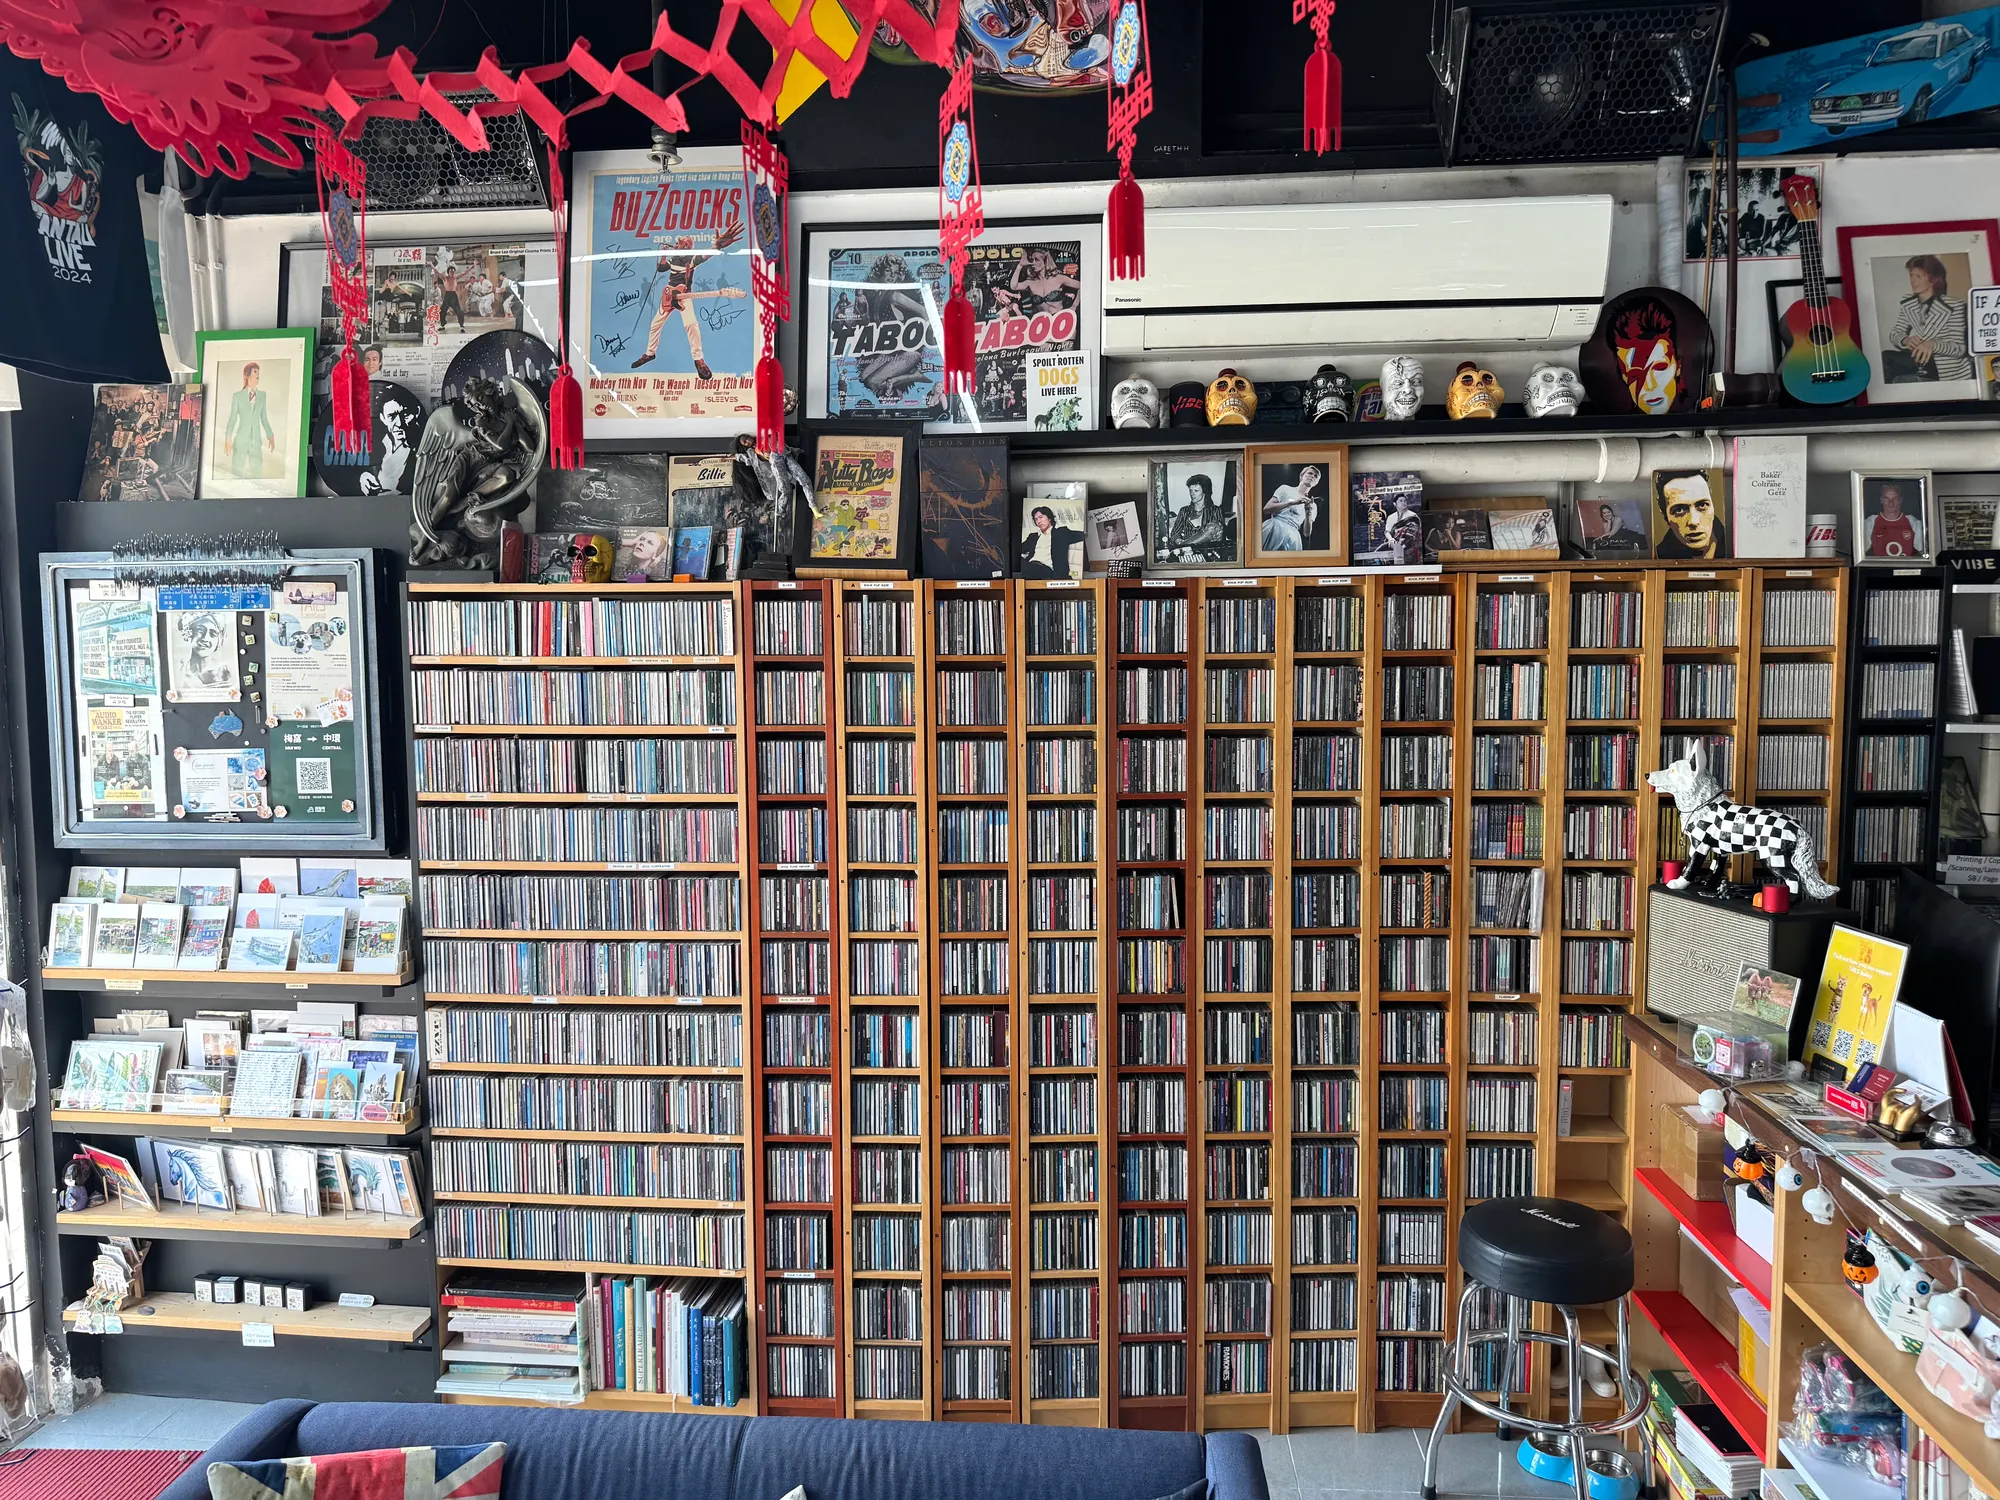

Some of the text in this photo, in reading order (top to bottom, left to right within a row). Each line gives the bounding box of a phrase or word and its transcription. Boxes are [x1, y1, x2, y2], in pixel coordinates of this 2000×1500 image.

[609, 183, 742, 238] BUZZCOCKS
[653, 235, 671, 243] are
[44, 235, 92, 271] LIVE
[52, 265, 92, 284] 2024
[1975, 296, 1988, 309] IF
[1978, 328, 1997, 338] THIS
[1985, 339, 1997, 348] BE
[1033, 356, 1084, 368] SPOILT ROTTEN
[1038, 366, 1080, 387] DOGS
[589, 377, 648, 390] Monday 11th Nov
[652, 378, 691, 390] The Wanch
[694, 377, 754, 391] Tuesday 12th Nov
[1041, 386, 1077, 396] LIVE HERE!
[697, 468, 727, 481] Billie
[816, 458, 861, 492] Nutty
[1760, 471, 1781, 479] Baker
[1751, 480, 1782, 488] Coltrane
[1767, 489, 1787, 497] Getz
[1951, 558, 1996, 570] VIBE
[92, 718, 122, 726] WANKER
[323, 733, 341, 743] 中環
[1956, 856, 1983, 864] Printing
[1680, 948, 1730, 980] Marshall
[1222, 1346, 1230, 1381] RAMONES
